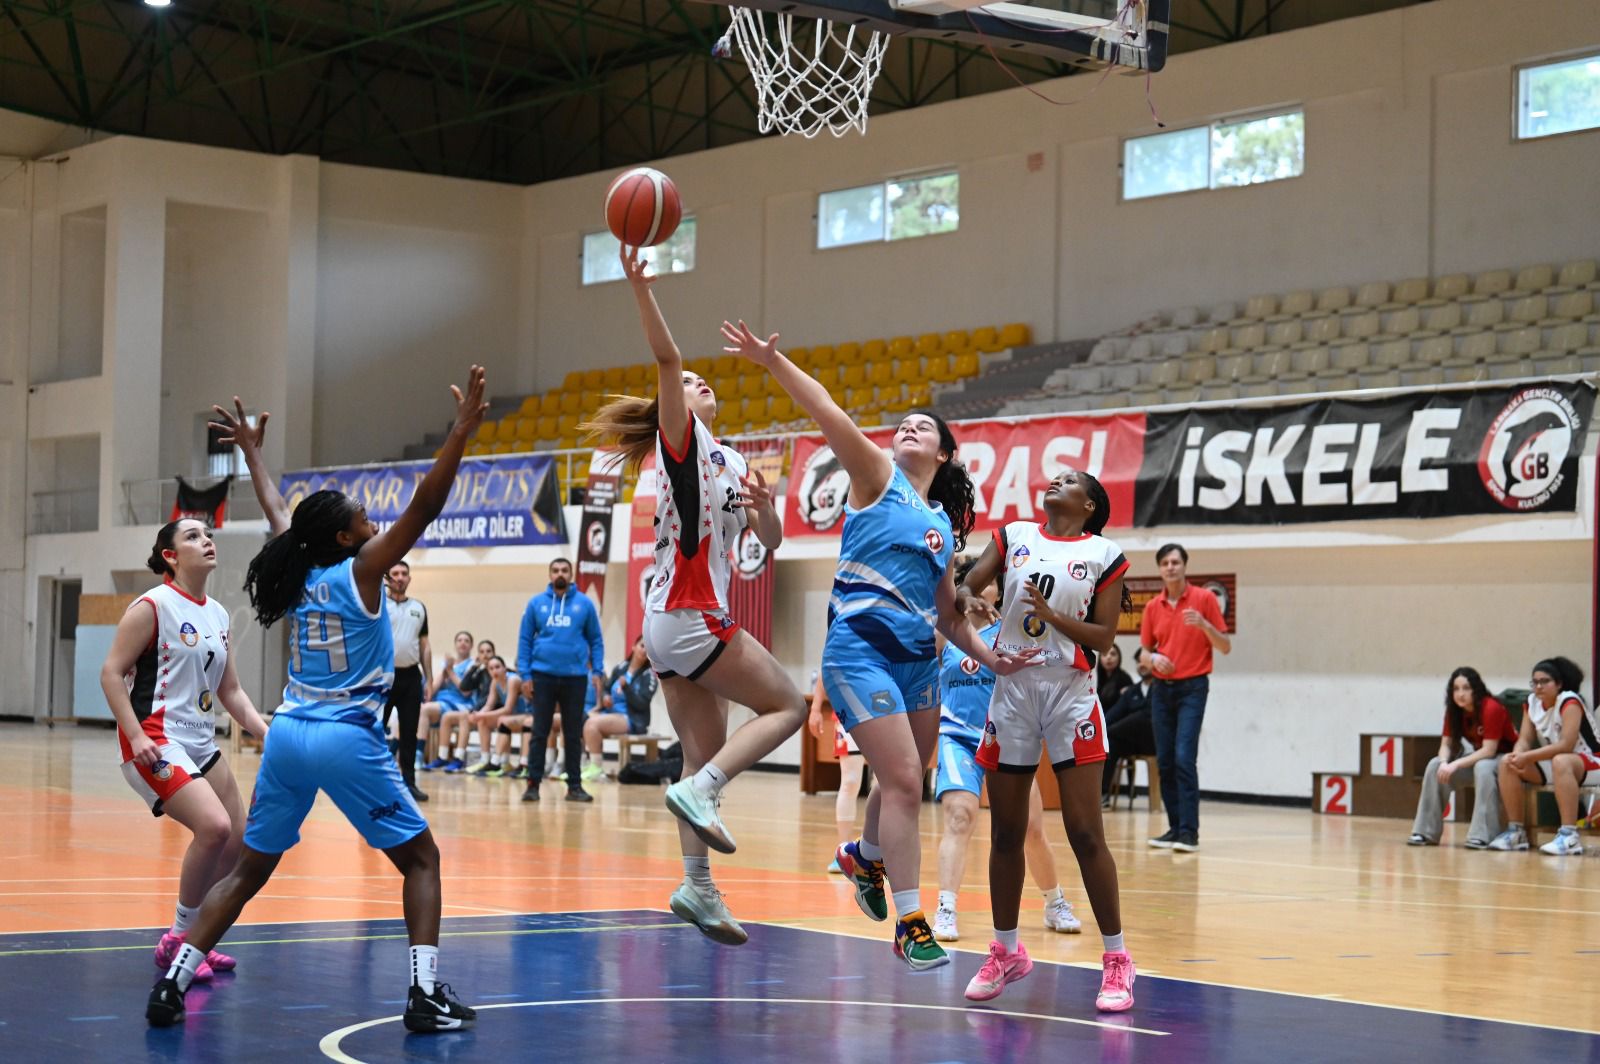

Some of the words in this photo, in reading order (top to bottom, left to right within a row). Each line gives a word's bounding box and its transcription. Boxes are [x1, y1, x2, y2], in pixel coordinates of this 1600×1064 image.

[1521, 453, 1549, 480] GB
[489, 511, 524, 538] DİLER
[1028, 572, 1056, 601] 10
[546, 614, 571, 627] ASB
[292, 611, 350, 673] 14
[203, 650, 215, 673] 7
[1379, 737, 1394, 777] 1
[1325, 776, 1348, 814] 2
